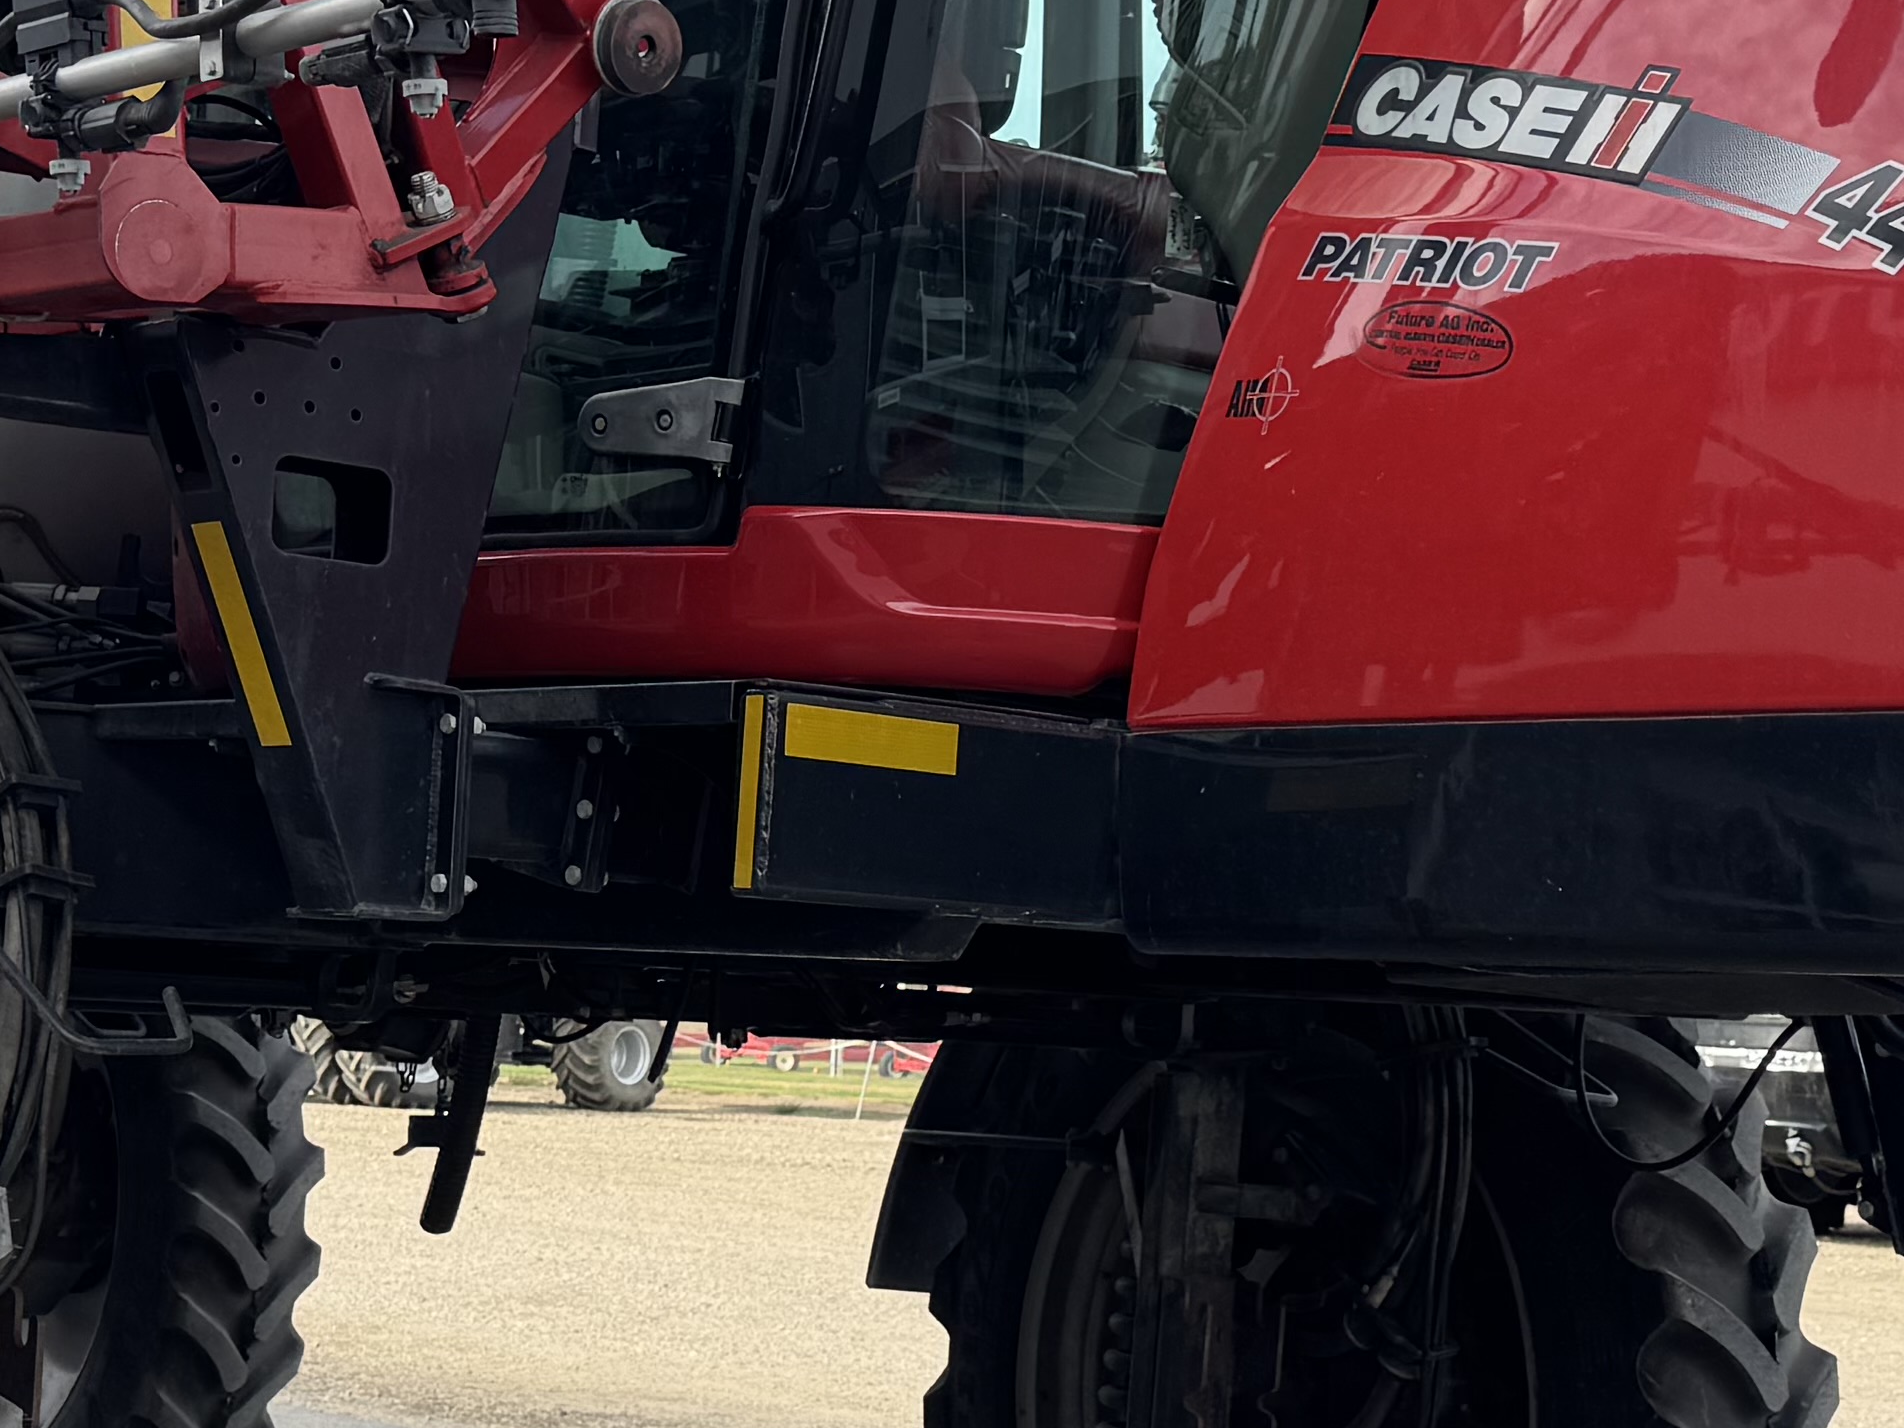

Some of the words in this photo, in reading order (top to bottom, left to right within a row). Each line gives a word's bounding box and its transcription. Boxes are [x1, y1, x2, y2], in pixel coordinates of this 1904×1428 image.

[1356, 66, 1588, 159] CASE
[1297, 232, 1560, 293] PATRIOT
[1387, 310, 1435, 327] Future
[1466, 315, 1494, 333] Inc.
